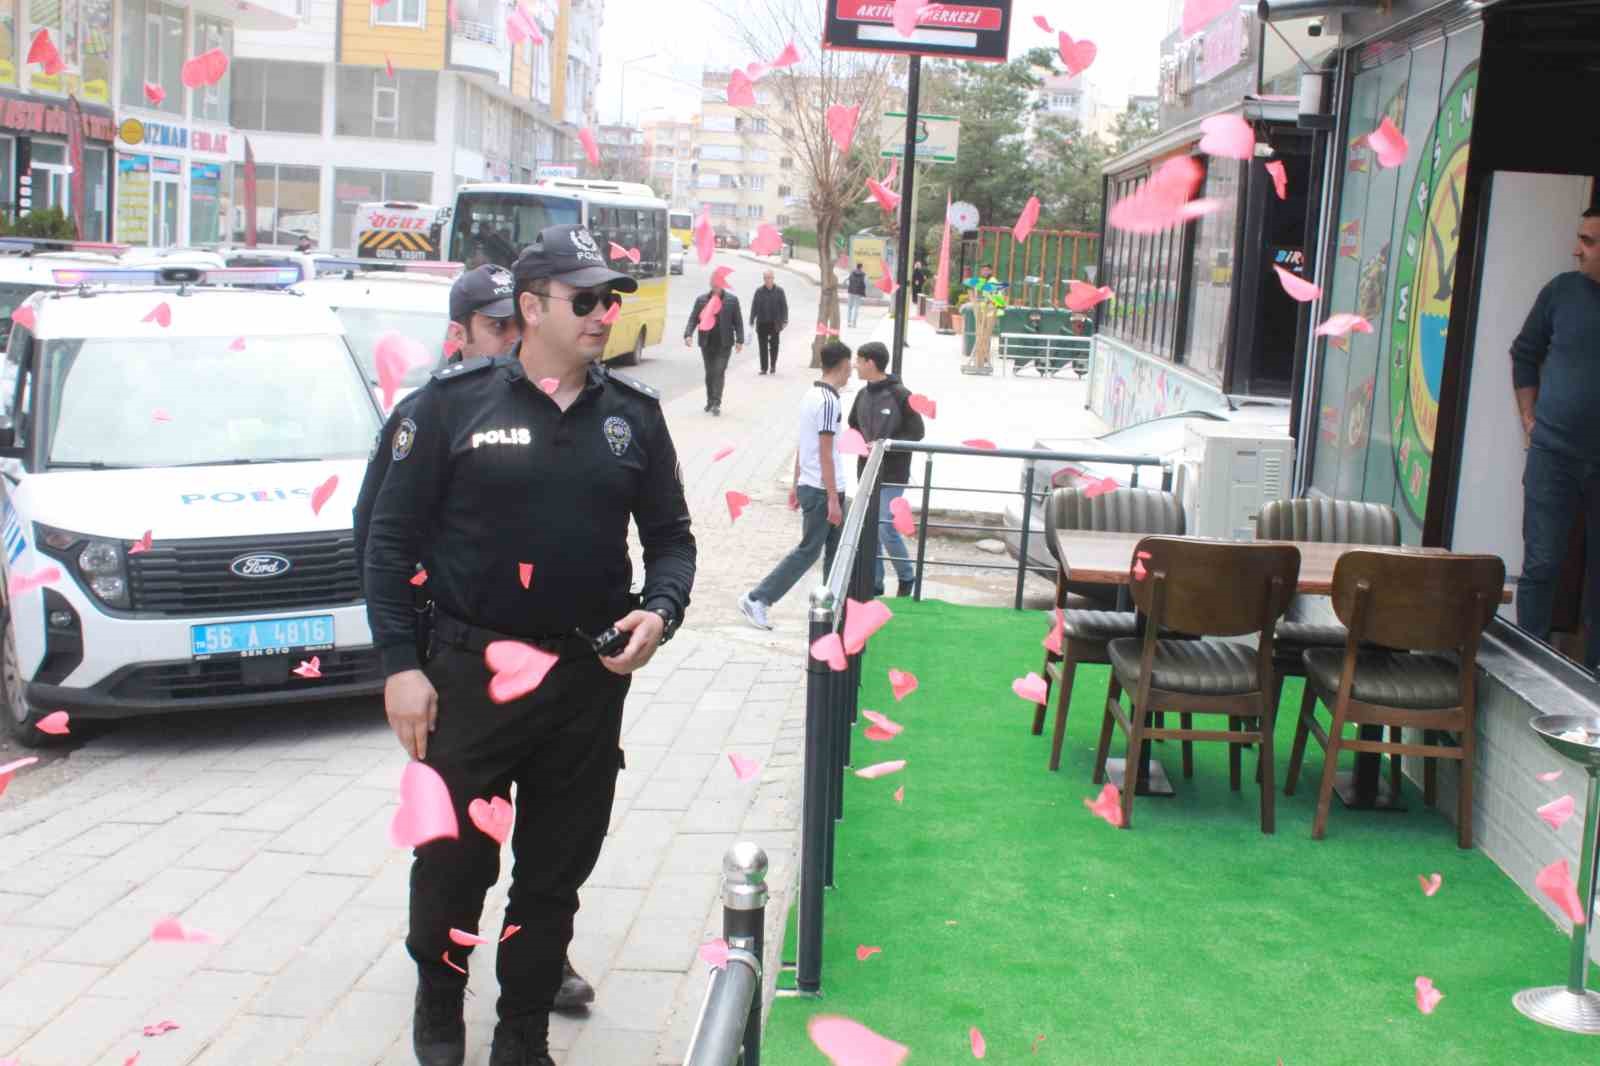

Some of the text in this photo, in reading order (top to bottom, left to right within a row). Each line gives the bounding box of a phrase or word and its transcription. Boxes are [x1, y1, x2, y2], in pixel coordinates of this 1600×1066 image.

[242, 558, 279, 574] Ford
[206, 619, 326, 650] 56 A 4816
